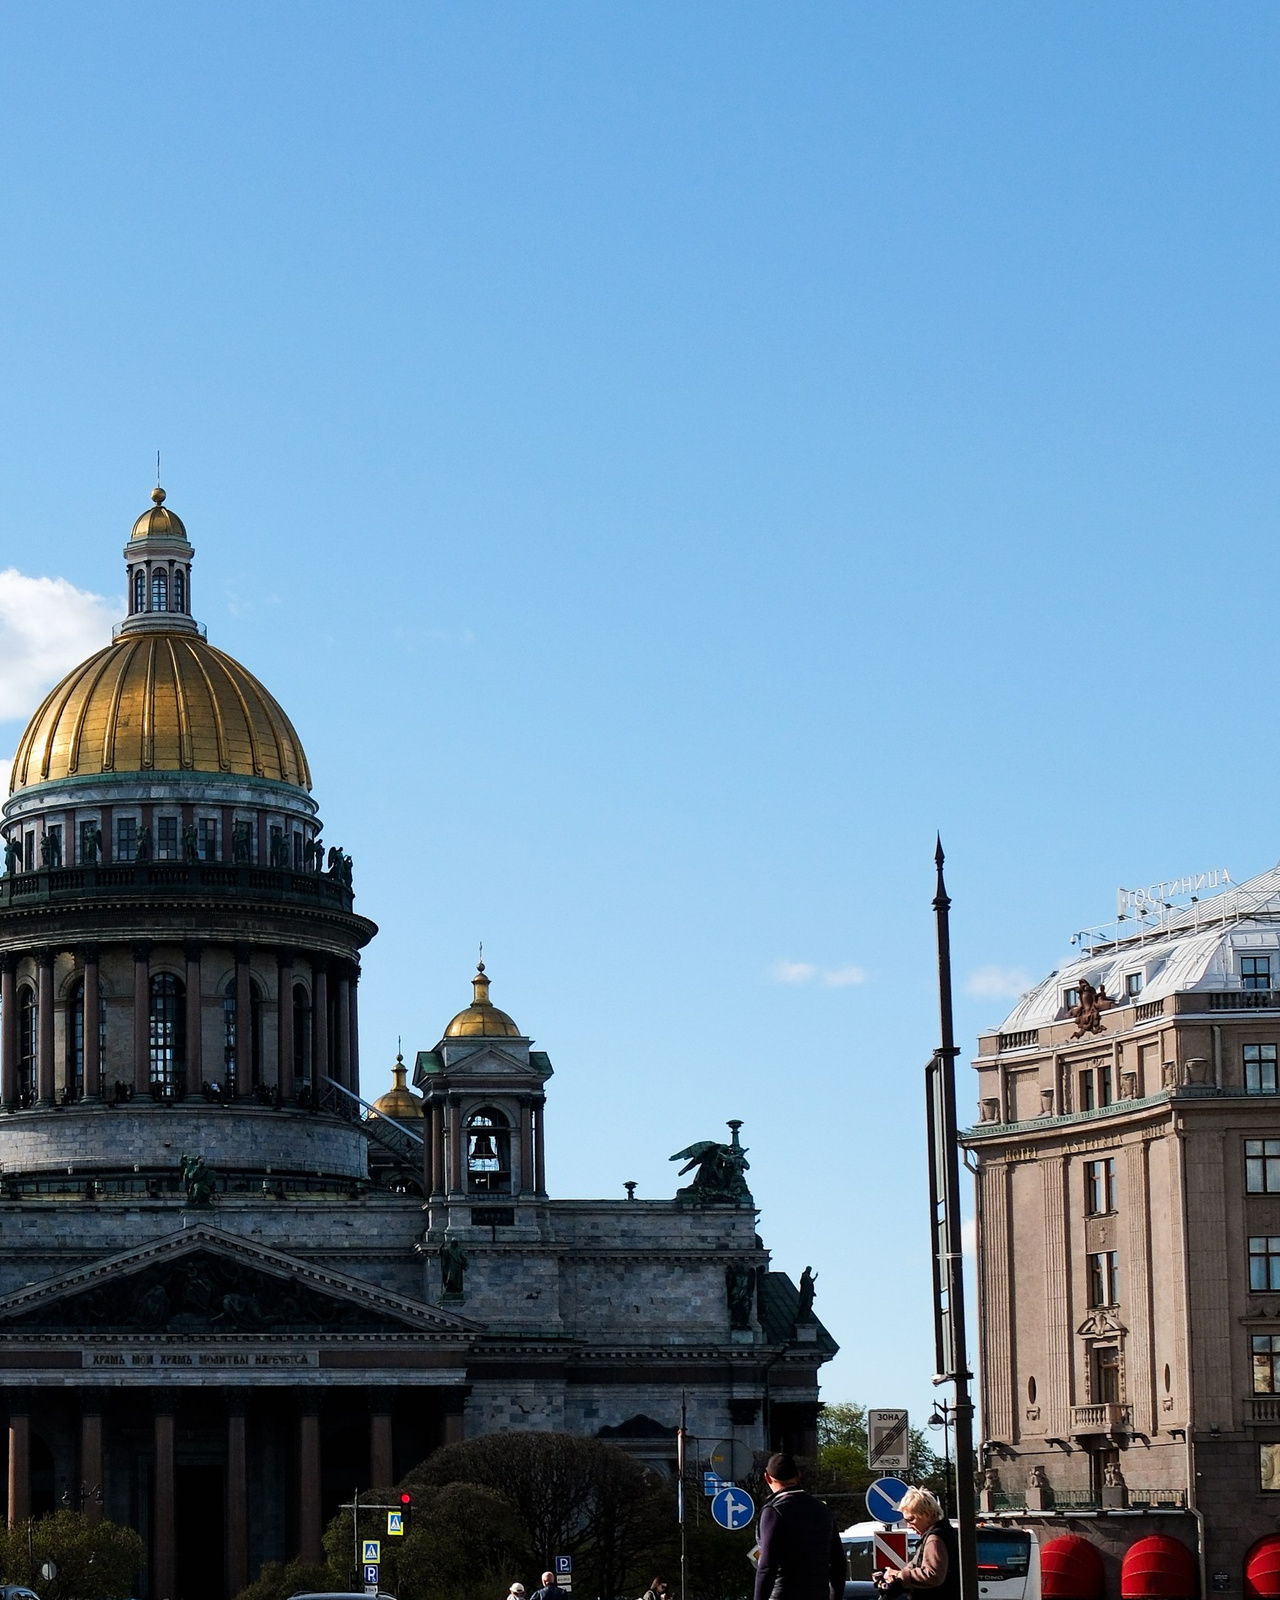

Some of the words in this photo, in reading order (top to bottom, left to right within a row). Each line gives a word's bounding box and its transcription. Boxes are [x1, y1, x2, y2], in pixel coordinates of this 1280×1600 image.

[1127, 868, 1231, 907] ГОСТИНИЦА
[1062, 1134, 1123, 1154] ASTORIA
[877, 1413, 900, 1421] ЗОНА
